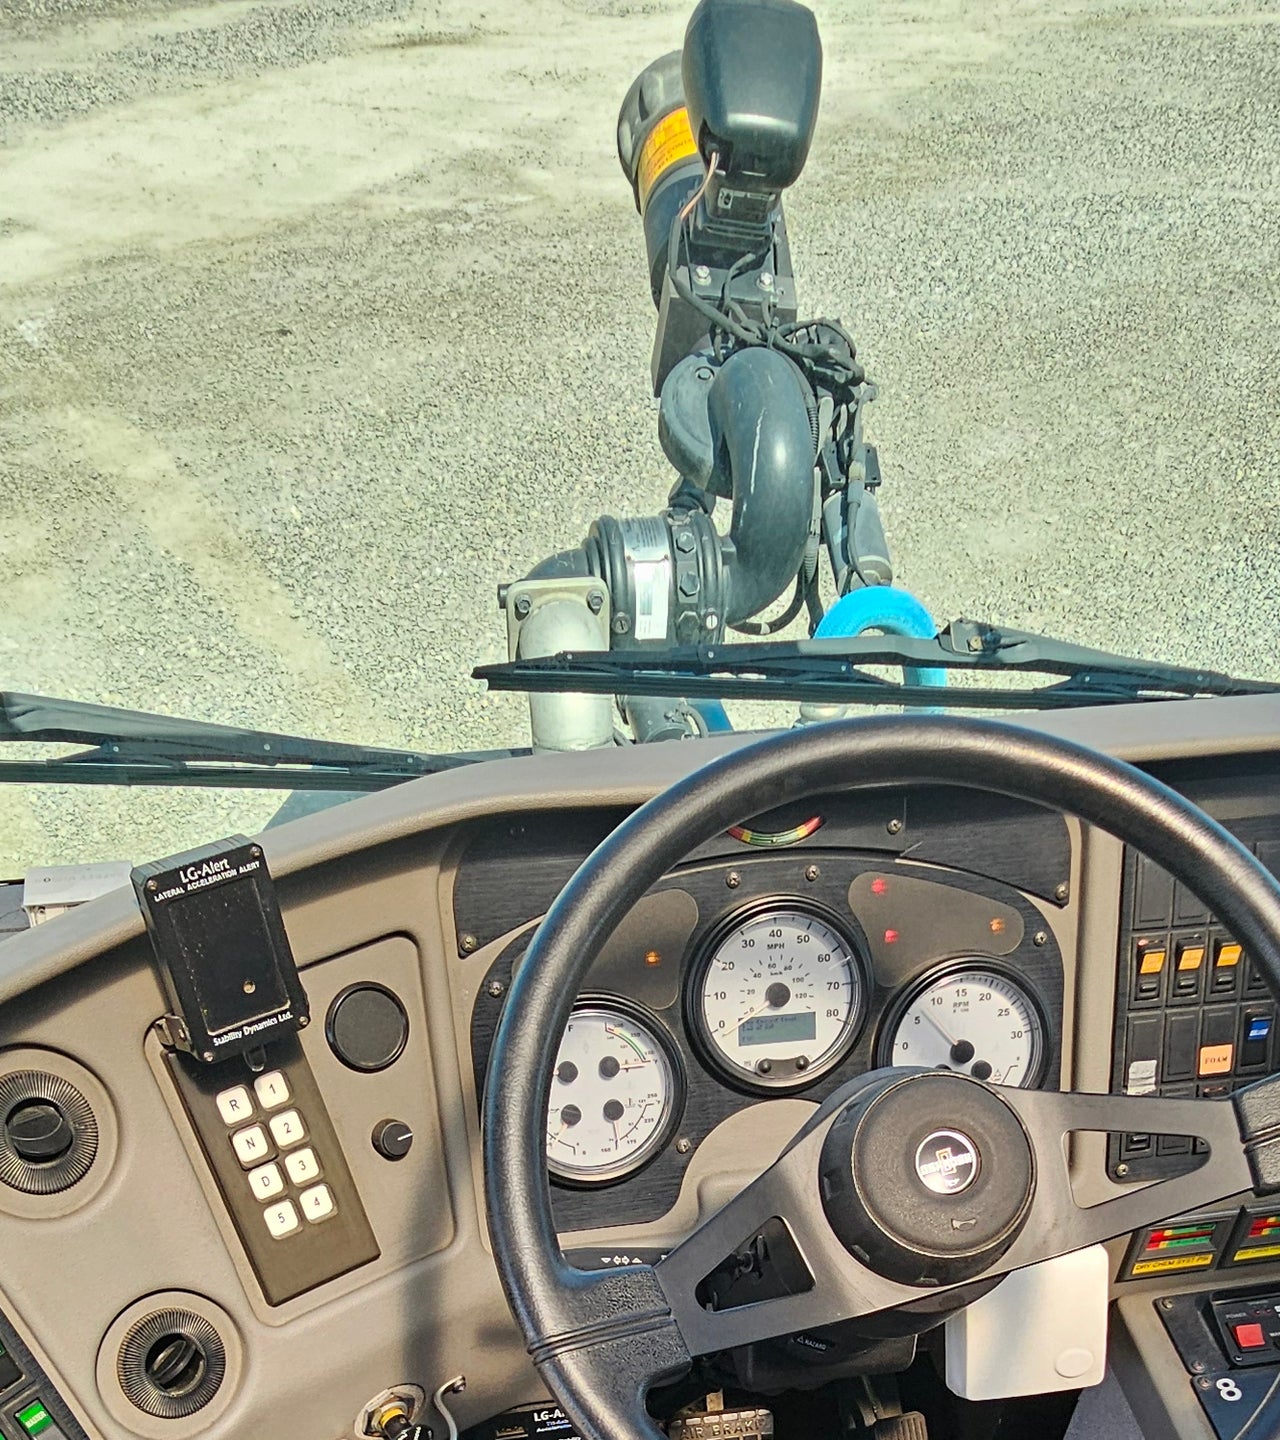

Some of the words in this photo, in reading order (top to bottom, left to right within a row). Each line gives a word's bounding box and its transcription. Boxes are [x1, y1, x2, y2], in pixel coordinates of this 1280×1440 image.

[154, 887, 185, 903] LATERAL
[187, 868, 238, 891] ACCELERATION
[239, 861, 260, 874] ALERT
[769, 929, 782, 938] 40
[742, 939, 755, 948] 30
[797, 935, 810, 944] 50
[817, 954, 831, 962] 60
[721, 962, 735, 971] 20
[826, 982, 839, 990] 70
[714, 992, 726, 1000] 10
[956, 989, 967, 997] 15
[979, 992, 992, 1001] 20
[931, 997, 943, 1006] 10
[826, 1009, 839, 1017] 80
[997, 1008, 1010, 1017] 25
[719, 1020, 725, 1028] 0
[914, 1016, 920, 1025] 5
[243, 1017, 278, 1036] Dynamics
[1010, 1031, 1023, 1039] 30
[902, 1042, 908, 1050] 0
[1205, 1056, 1228, 1065] FOAM
[269, 1084, 276, 1095] 1
[229, 1099, 240, 1111] R
[283, 1122, 292, 1134] 2
[245, 1137, 256, 1149] N
[298, 1160, 306, 1171] 3
[261, 1175, 270, 1187] D
[313, 1197, 320, 1206] 4
[277, 1212, 286, 1224] 5
[1152, 1260, 1175, 1269] CHEM
